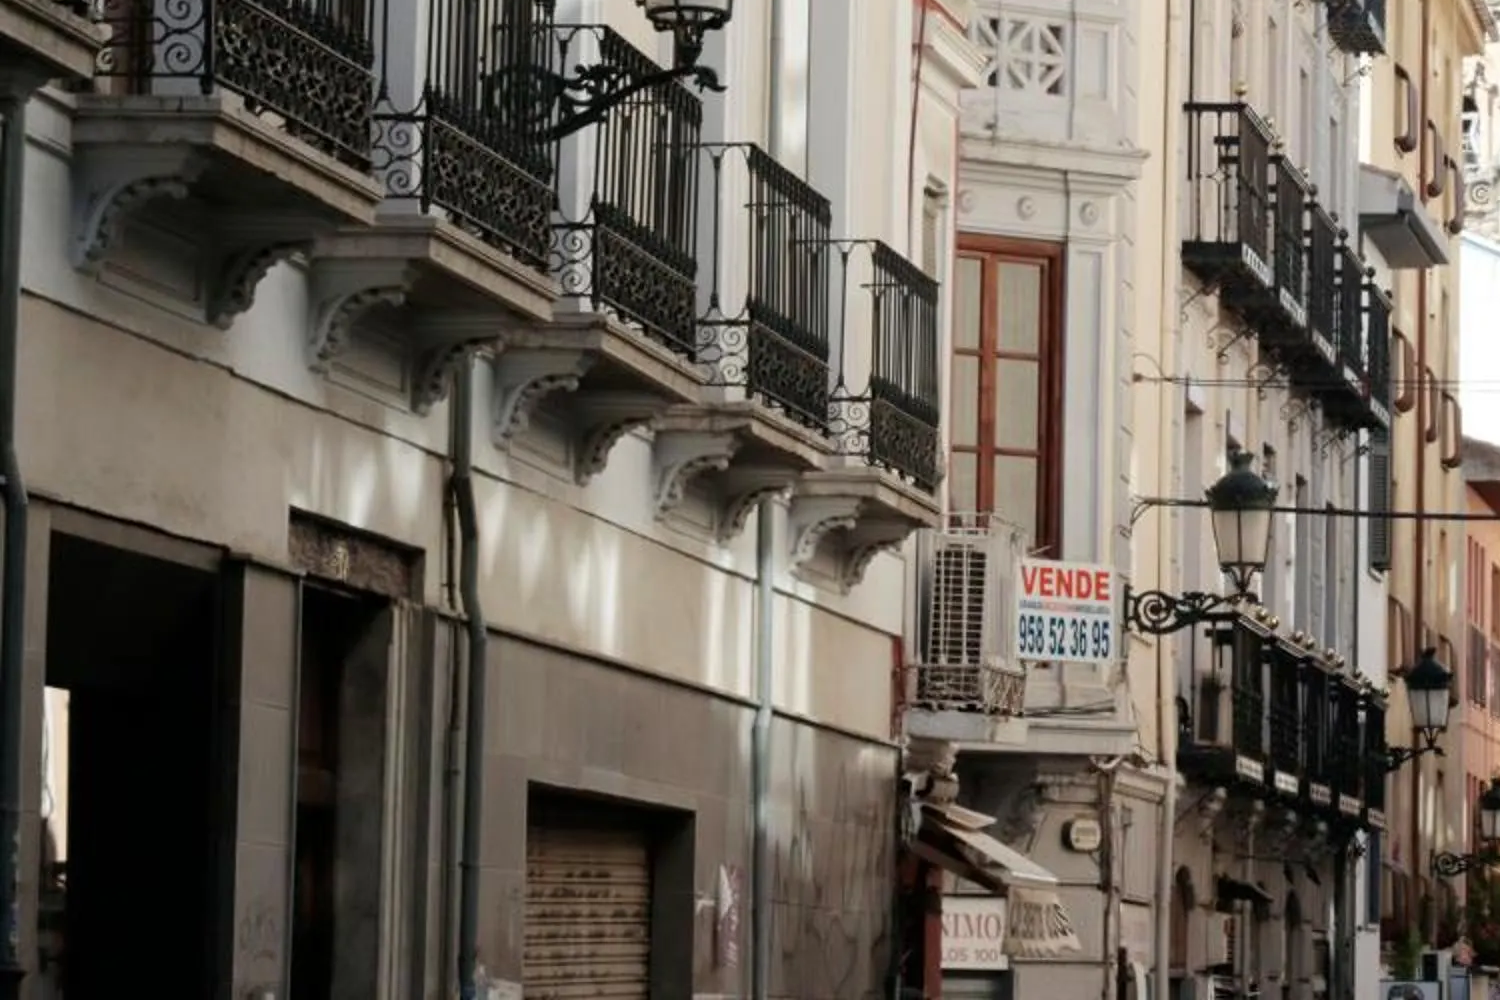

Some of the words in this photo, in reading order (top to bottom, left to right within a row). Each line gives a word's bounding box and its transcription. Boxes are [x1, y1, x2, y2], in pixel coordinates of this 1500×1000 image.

[1021, 565, 1110, 601] VENDE
[1019, 613, 1045, 653] 958
[1049, 616, 1065, 656] 52
[1070, 618, 1087, 657] 36
[1092, 620, 1110, 659] 95
